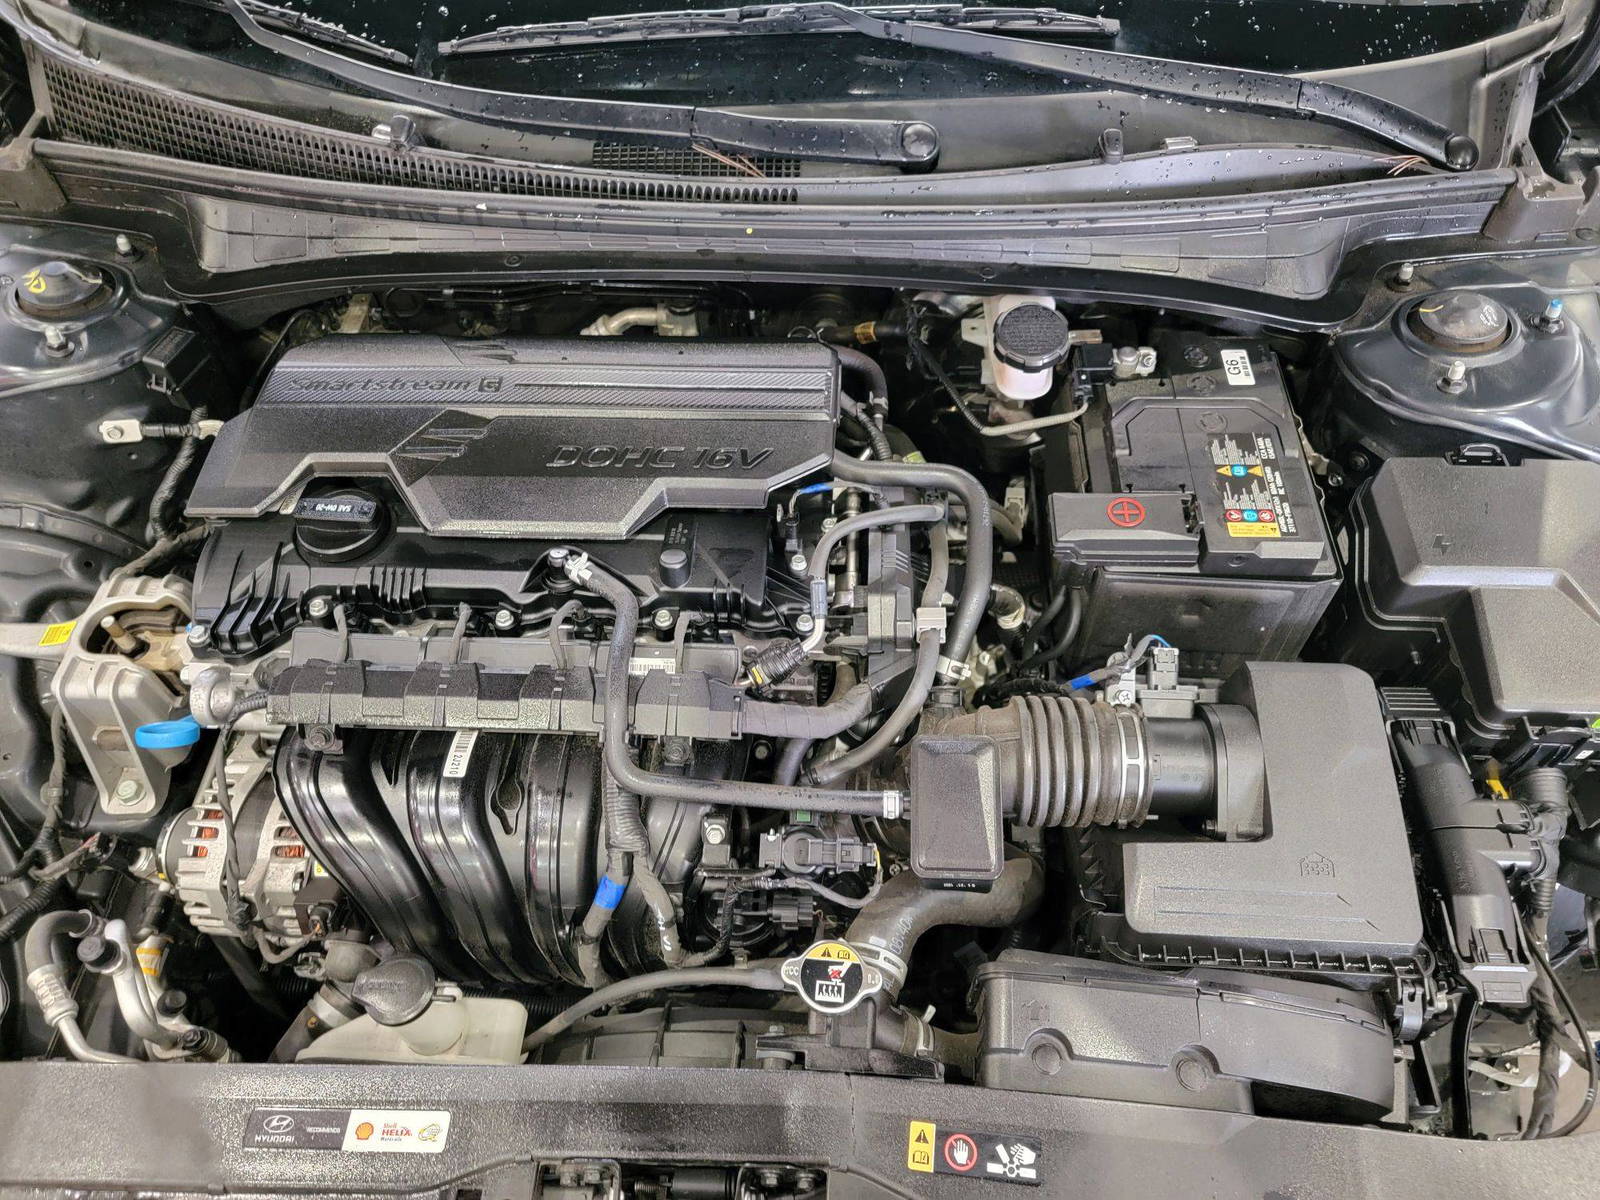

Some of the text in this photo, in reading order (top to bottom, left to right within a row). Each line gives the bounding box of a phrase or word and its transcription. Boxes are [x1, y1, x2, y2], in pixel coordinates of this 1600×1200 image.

[1226, 359, 1241, 376] G6
[287, 376, 472, 393] Smartstream
[546, 445, 775, 470] DOHC 16V
[337, 504, 352, 513] SAE
[254, 1134, 295, 1143] HYUNDAI
[381, 1128, 412, 1137] HELIX
